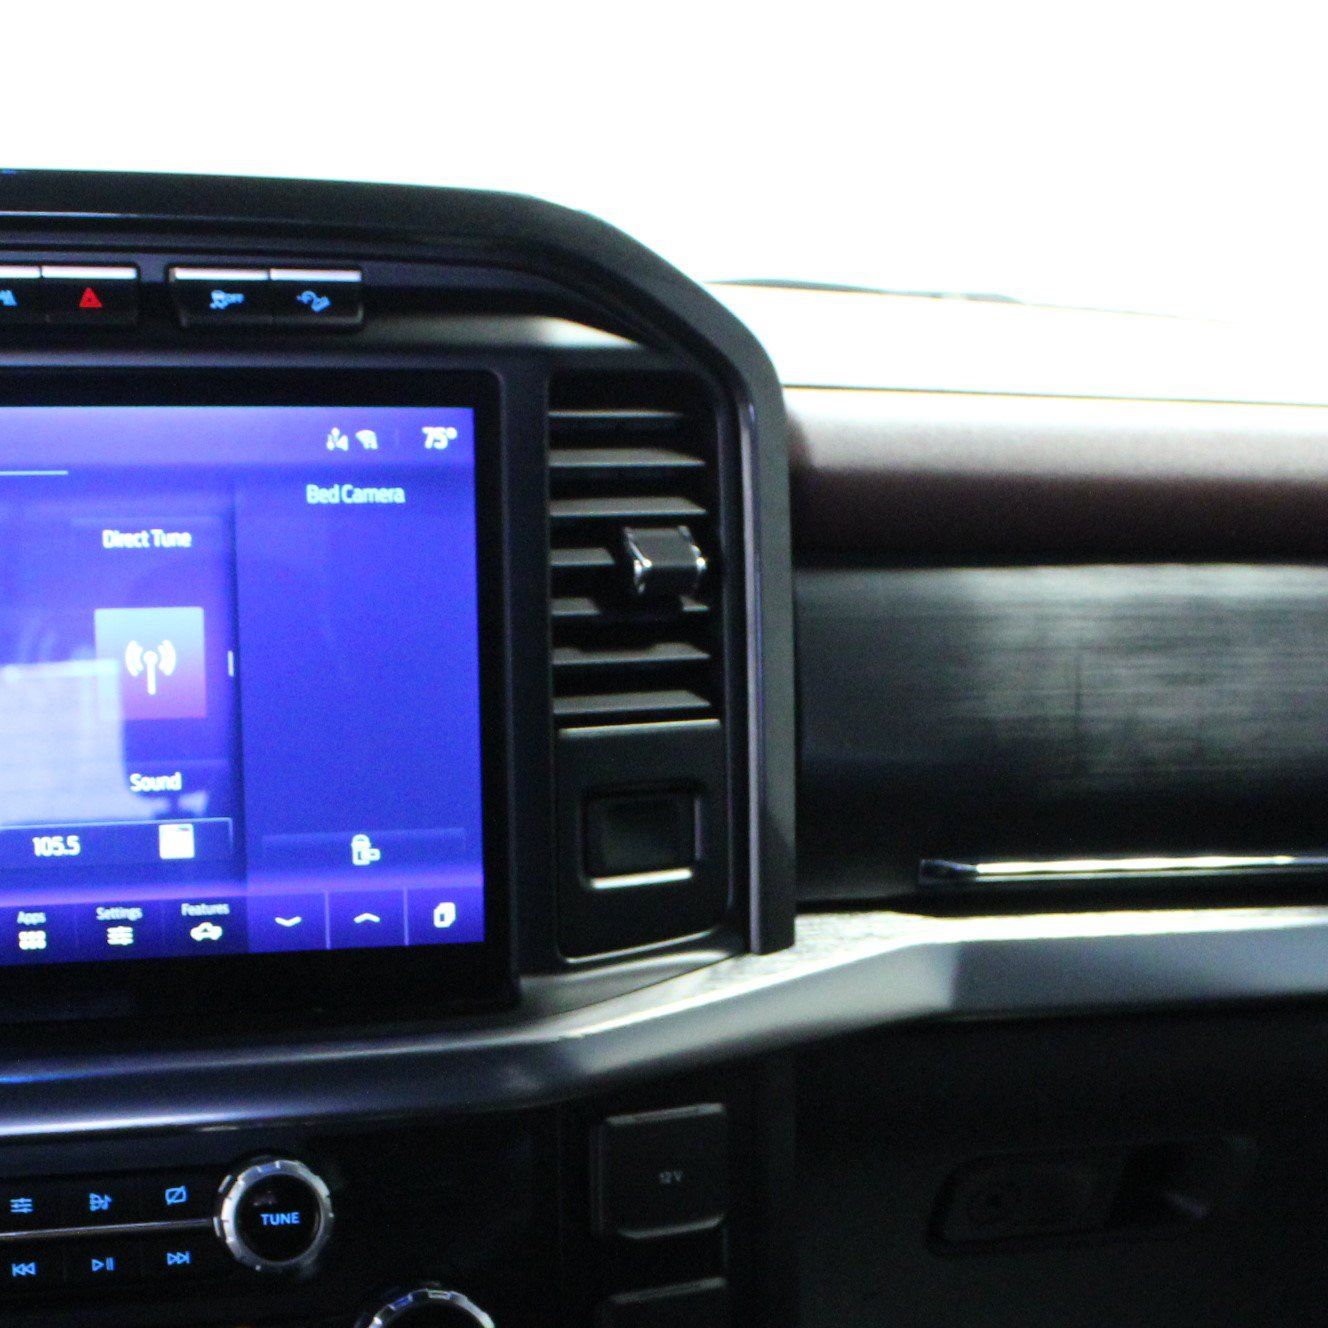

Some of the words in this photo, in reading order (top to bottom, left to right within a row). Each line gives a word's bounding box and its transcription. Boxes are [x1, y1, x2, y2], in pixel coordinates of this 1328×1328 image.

[306, 484, 339, 504] Bed
[341, 485, 406, 504] Camera
[102, 530, 150, 549] Direct
[151, 529, 192, 548] Tune
[130, 772, 182, 792] Sound
[32, 835, 81, 857] 105.5
[17, 911, 46, 926] Apps
[96, 906, 142, 922] Settings
[181, 903, 230, 918] Features
[261, 1211, 301, 1226] TUNE
